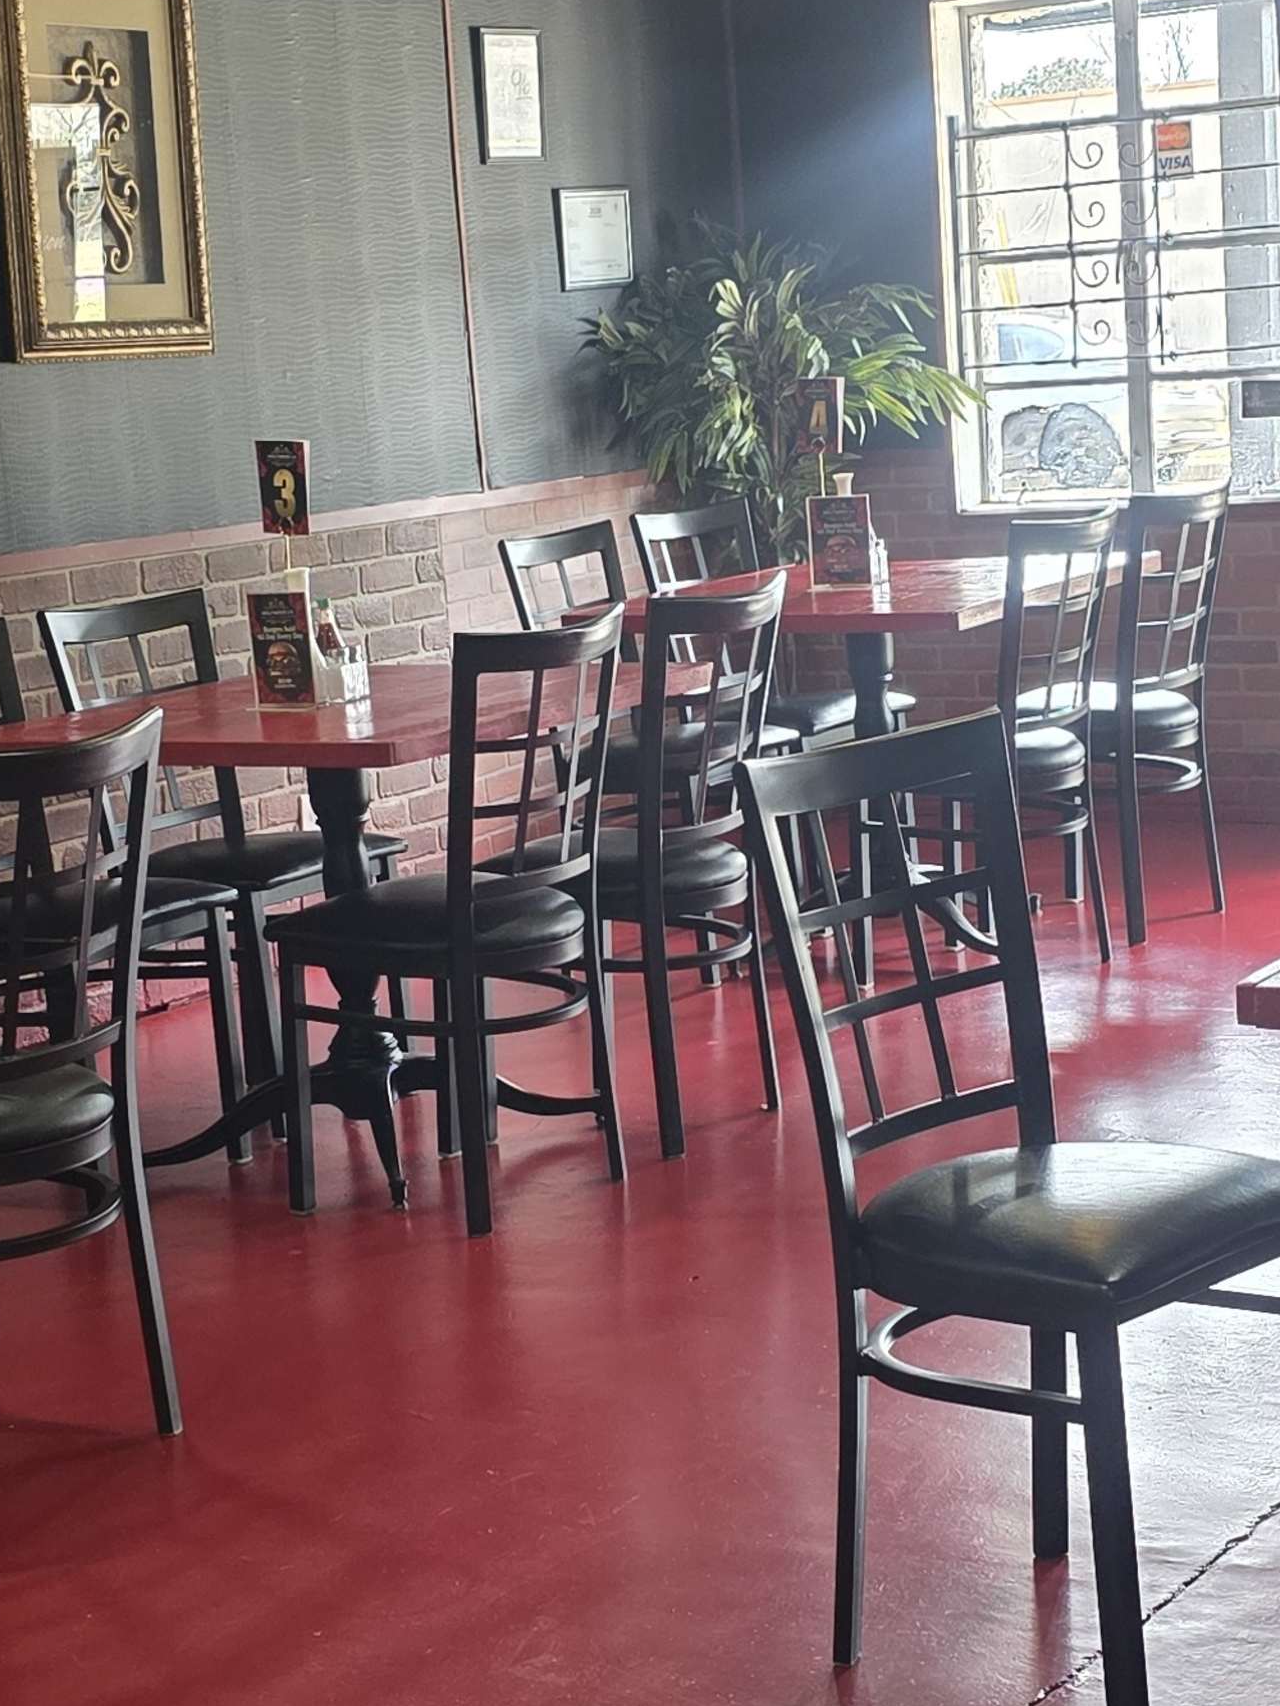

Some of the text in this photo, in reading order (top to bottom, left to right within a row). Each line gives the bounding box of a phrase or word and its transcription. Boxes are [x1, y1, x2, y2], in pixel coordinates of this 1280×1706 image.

[1159, 154, 1192, 170] VISA
[808, 399, 829, 437] 4
[273, 468, 296, 518] 3
